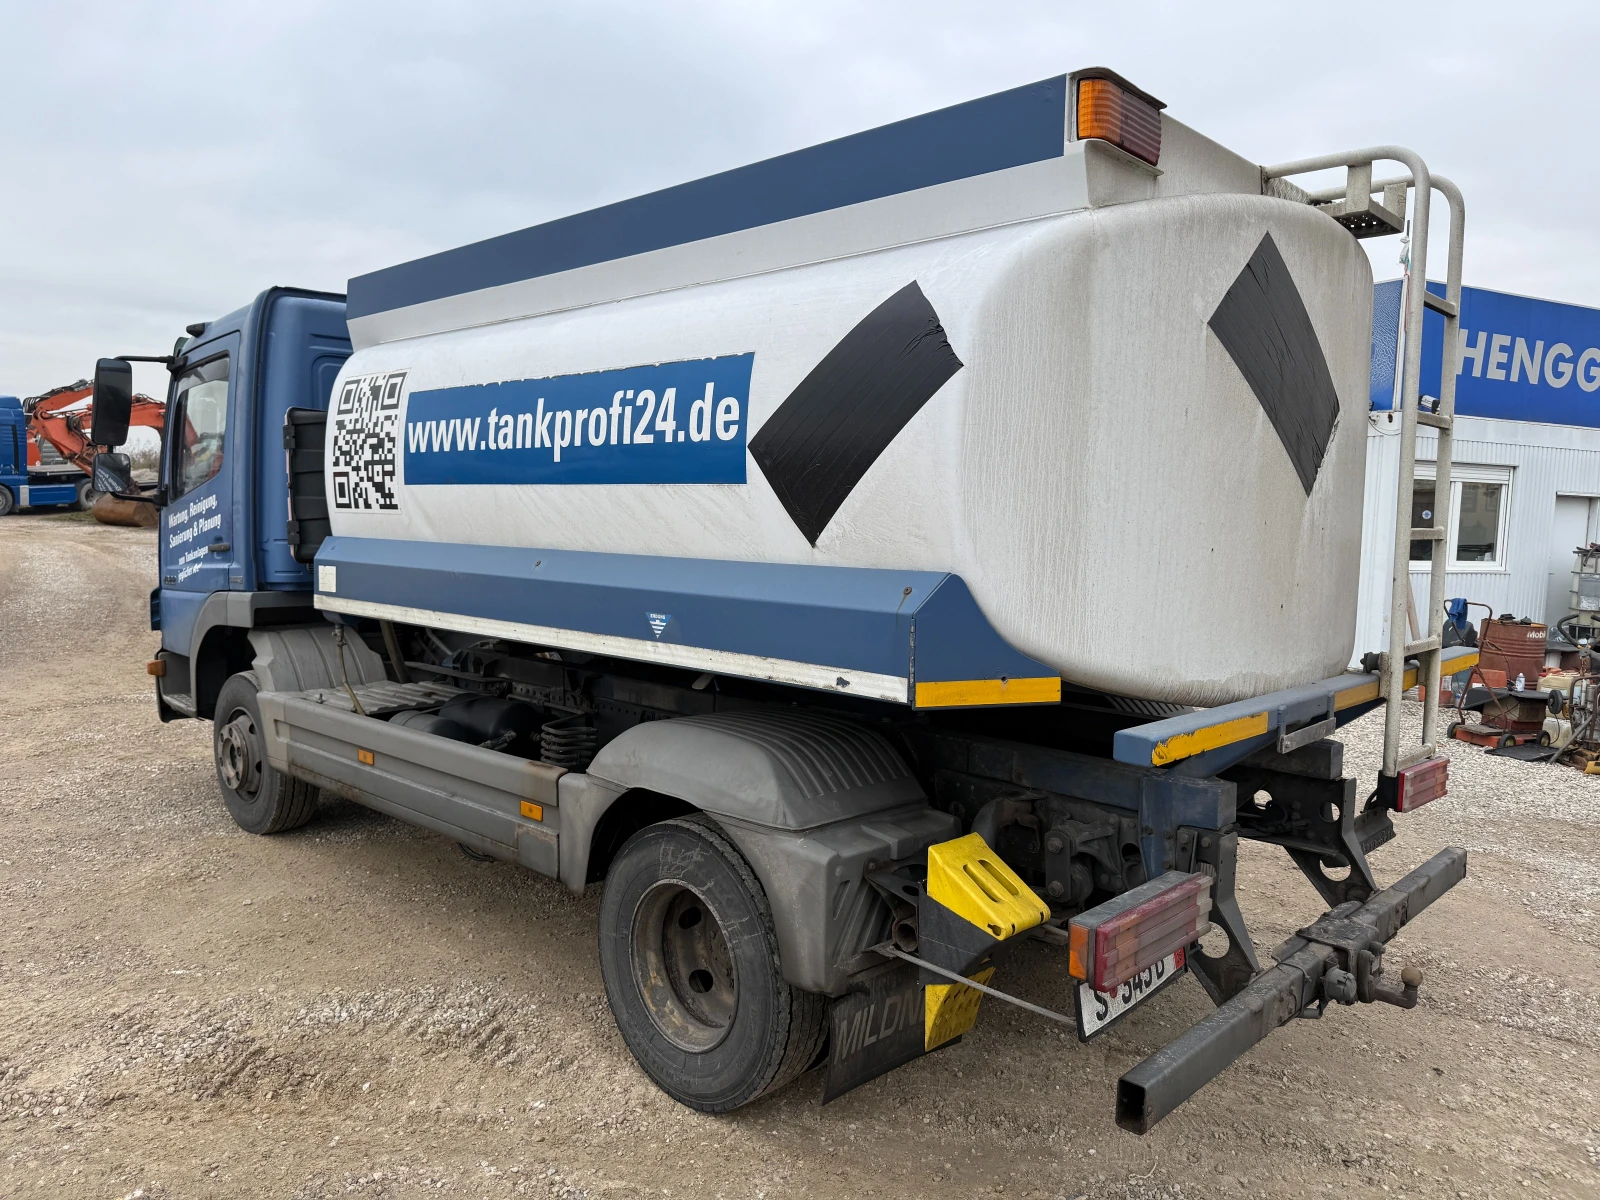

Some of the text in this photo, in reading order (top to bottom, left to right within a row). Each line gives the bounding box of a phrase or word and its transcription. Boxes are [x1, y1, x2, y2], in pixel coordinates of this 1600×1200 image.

[1455, 328, 1600, 393] HENGG
[407, 382, 740, 463] www.tankprofi24.de
[190, 494, 217, 517] Reinigung,
[170, 514, 221, 548] Sanierung & Planung
